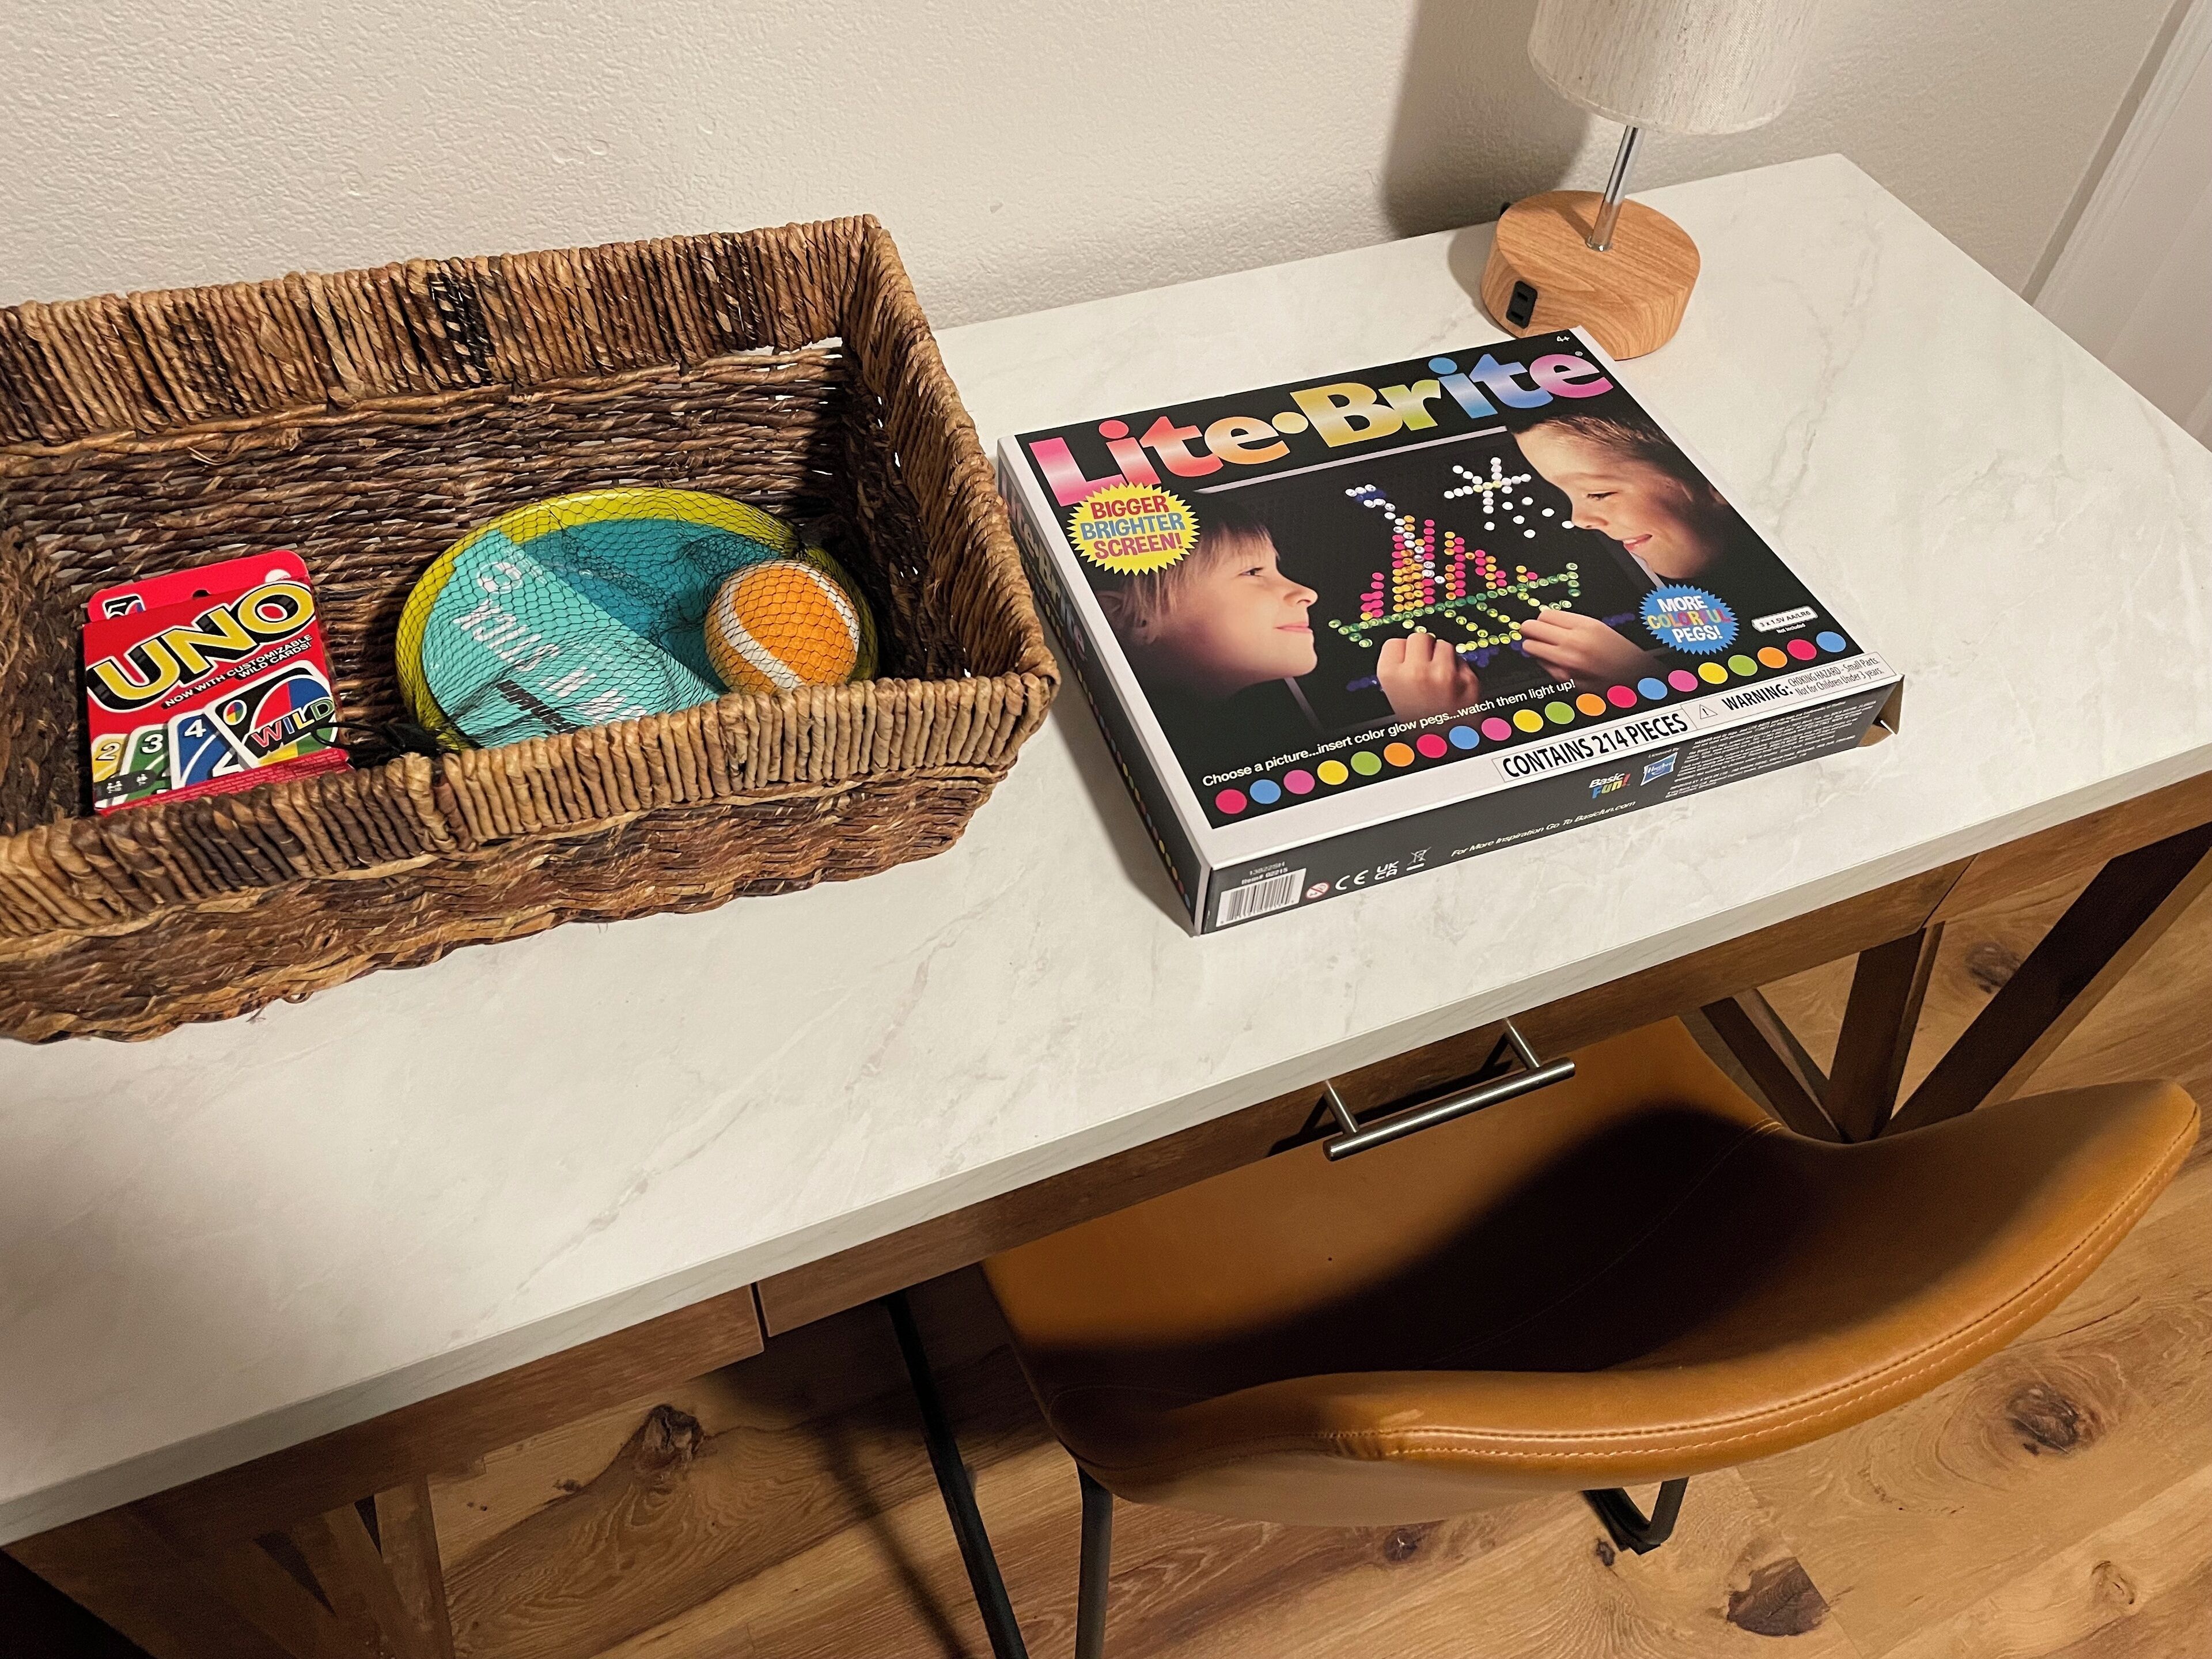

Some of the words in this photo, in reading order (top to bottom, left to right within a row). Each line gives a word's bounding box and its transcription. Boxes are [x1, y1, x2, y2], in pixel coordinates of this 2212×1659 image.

[1090, 495, 1170, 519] BIGGER
[1080, 512, 1185, 540] BRIGHTER
[1093, 532, 1184, 559] SCREEN!
[1657, 596, 1708, 612] MORE
[1647, 608, 1732, 629] COLORFUL
[89, 581, 315, 707] UNO
[1672, 625, 1724, 643] PEGS!
[165, 691, 194, 707] NOW
[195, 675, 225, 691] WITH
[228, 634, 313, 677] CUSTOMIZABLE
[237, 661, 269, 678] WILD
[268, 642, 312, 664] CARDS!
[1788, 673, 1816, 687] CHOKING
[1816, 666, 1841, 680] HAZARD
[1843, 660, 1861, 672] Small
[1795, 687, 1808, 696] Not
[1808, 685, 1817, 695] for
[1816, 677, 1844, 691] Children
[1843, 673, 1862, 684] Under
[1864, 667, 1884, 679] years.
[1721, 683, 1794, 711] WARNING:
[184, 719, 207, 738] 4
[249, 699, 334, 749] WILD
[1202, 765, 1252, 787] Choose
[1254, 763, 1264, 772] a
[1354, 728, 1385, 744] color
[1388, 720, 1417, 737] glow
[1497, 692, 1528, 708] them
[1528, 684, 1555, 700] light
[1557, 678, 1576, 694] up!
[95, 742, 121, 761] 2
[142, 734, 164, 753] 3
[1502, 738, 1594, 778] CONTAINS
[1592, 729, 1630, 754] 214
[1626, 713, 1688, 744] PIECES
[1589, 772, 1626, 789] Basic
[1450, 848, 1469, 857] For
[1468, 840, 1495, 852] More
[1495, 827, 1544, 844] Inspiration
[1546, 822, 1560, 831] Go
[1574, 800, 1637, 823] Basicfun.com
[1374, 868, 1398, 881] CA
[1376, 860, 1400, 873] UK
